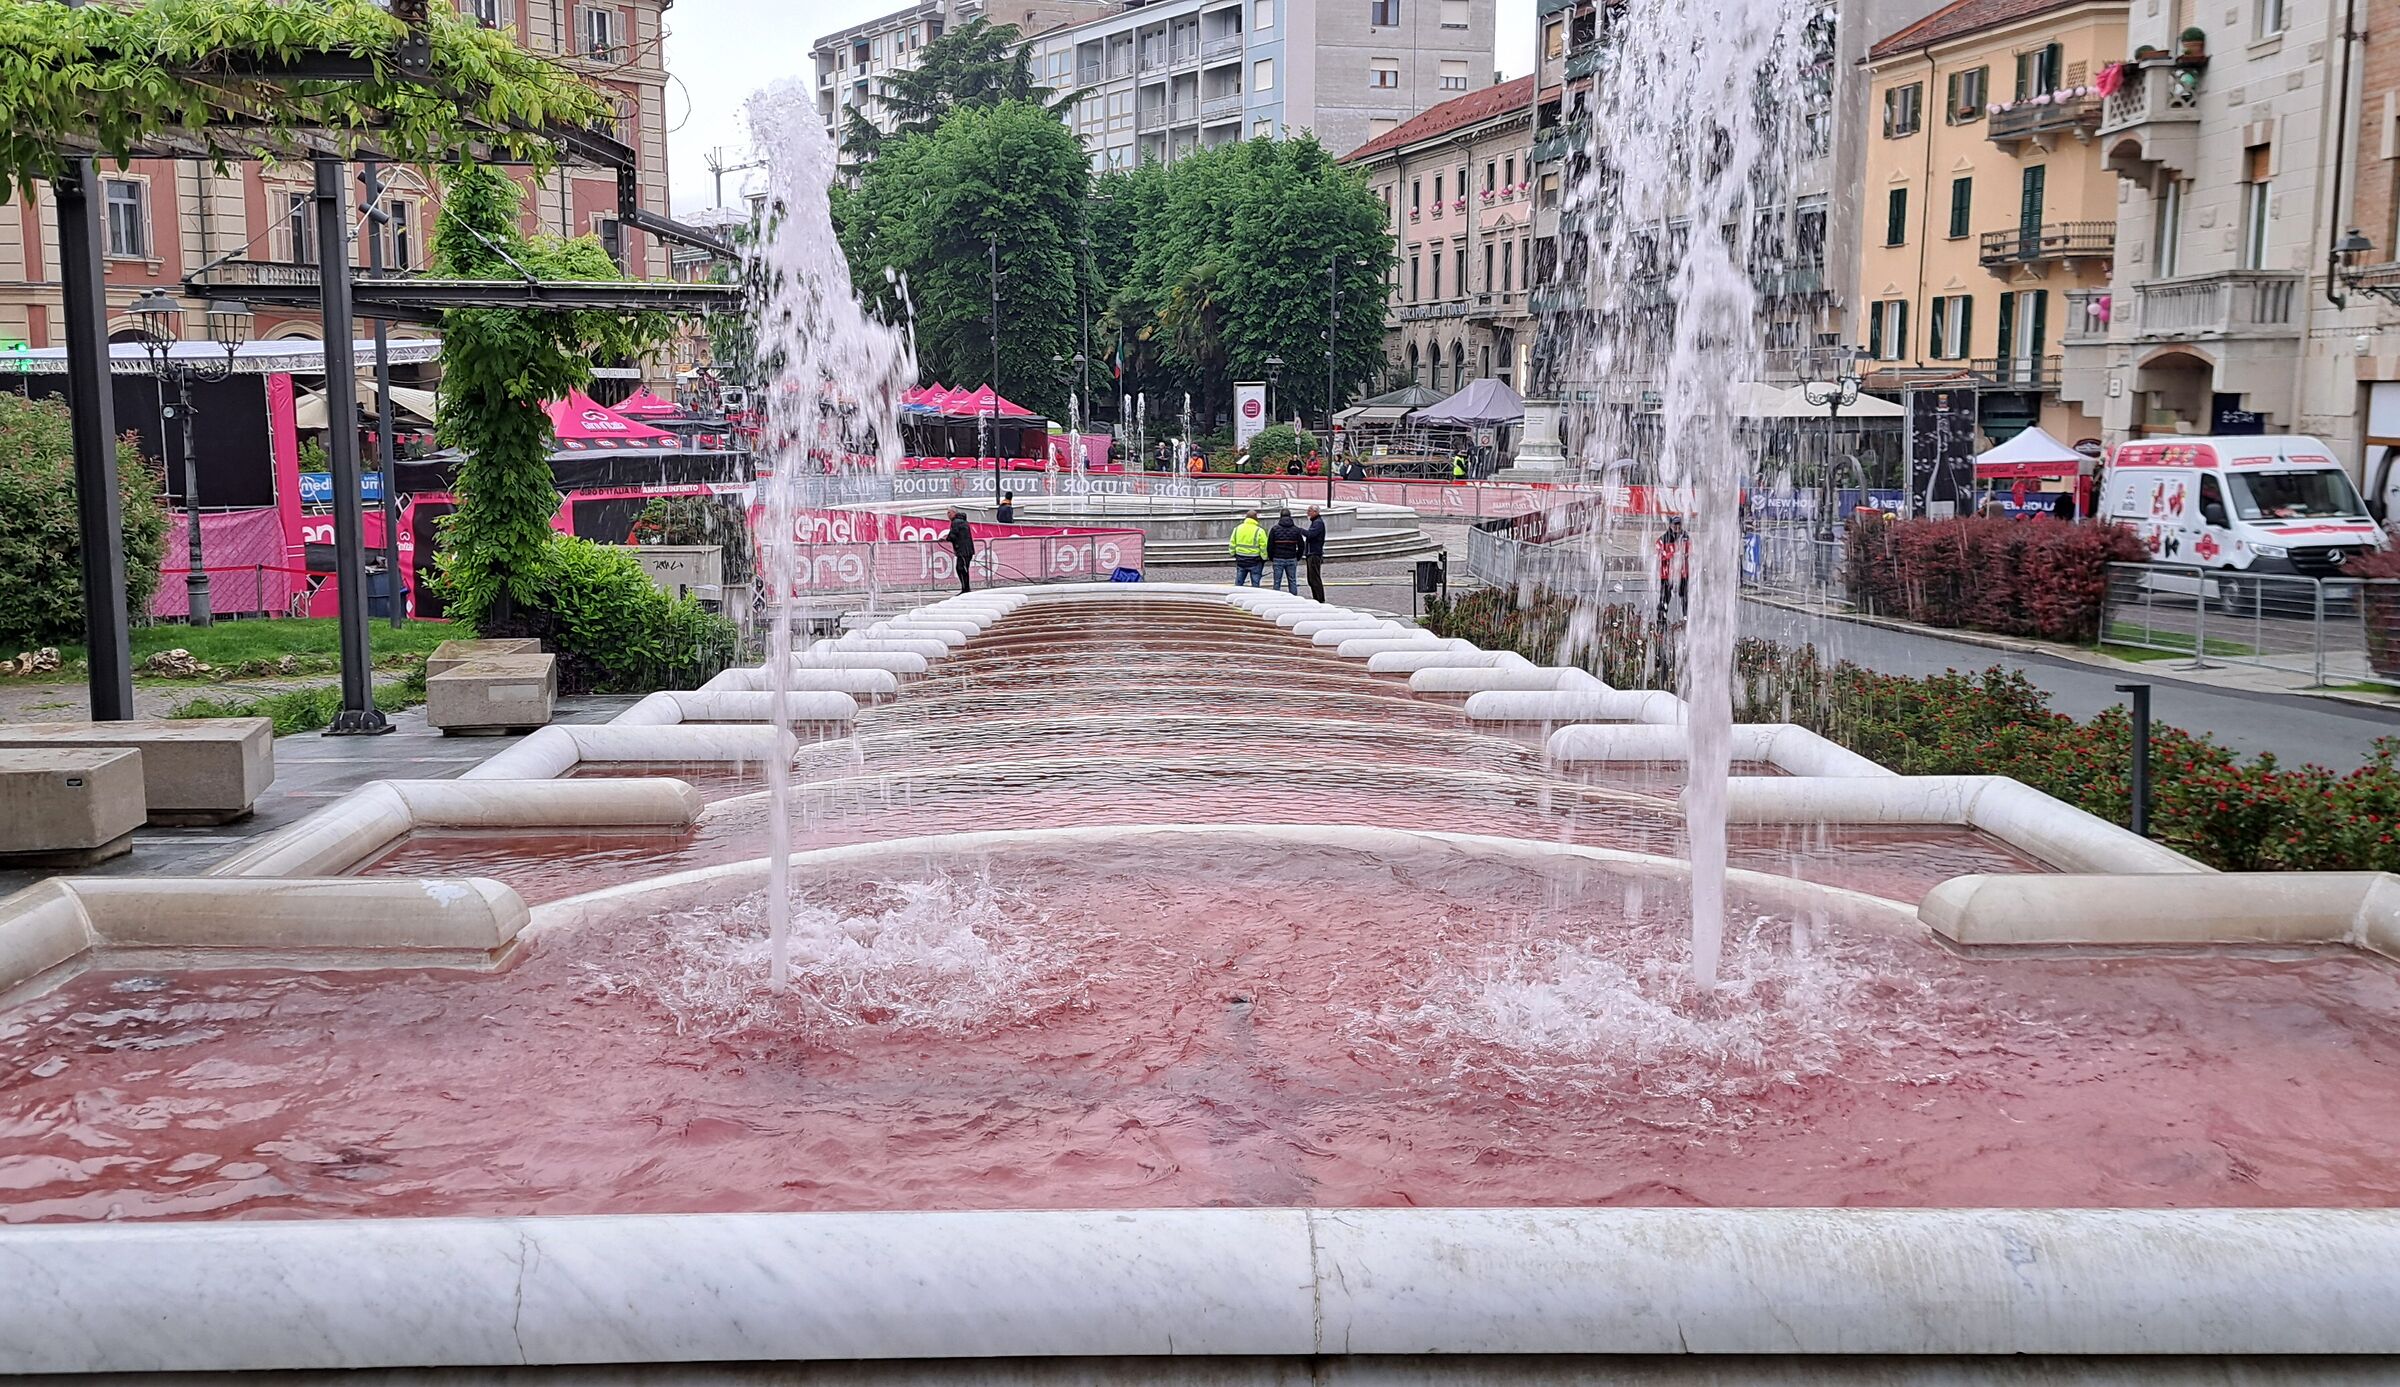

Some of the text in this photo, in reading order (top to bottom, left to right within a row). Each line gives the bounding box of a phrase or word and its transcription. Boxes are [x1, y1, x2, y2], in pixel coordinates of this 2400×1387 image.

[642, 485, 668, 494] AMORE
[669, 484, 698, 493] INFINITO
[1768, 498, 1791, 507] NEW
[795, 513, 858, 543] enel
